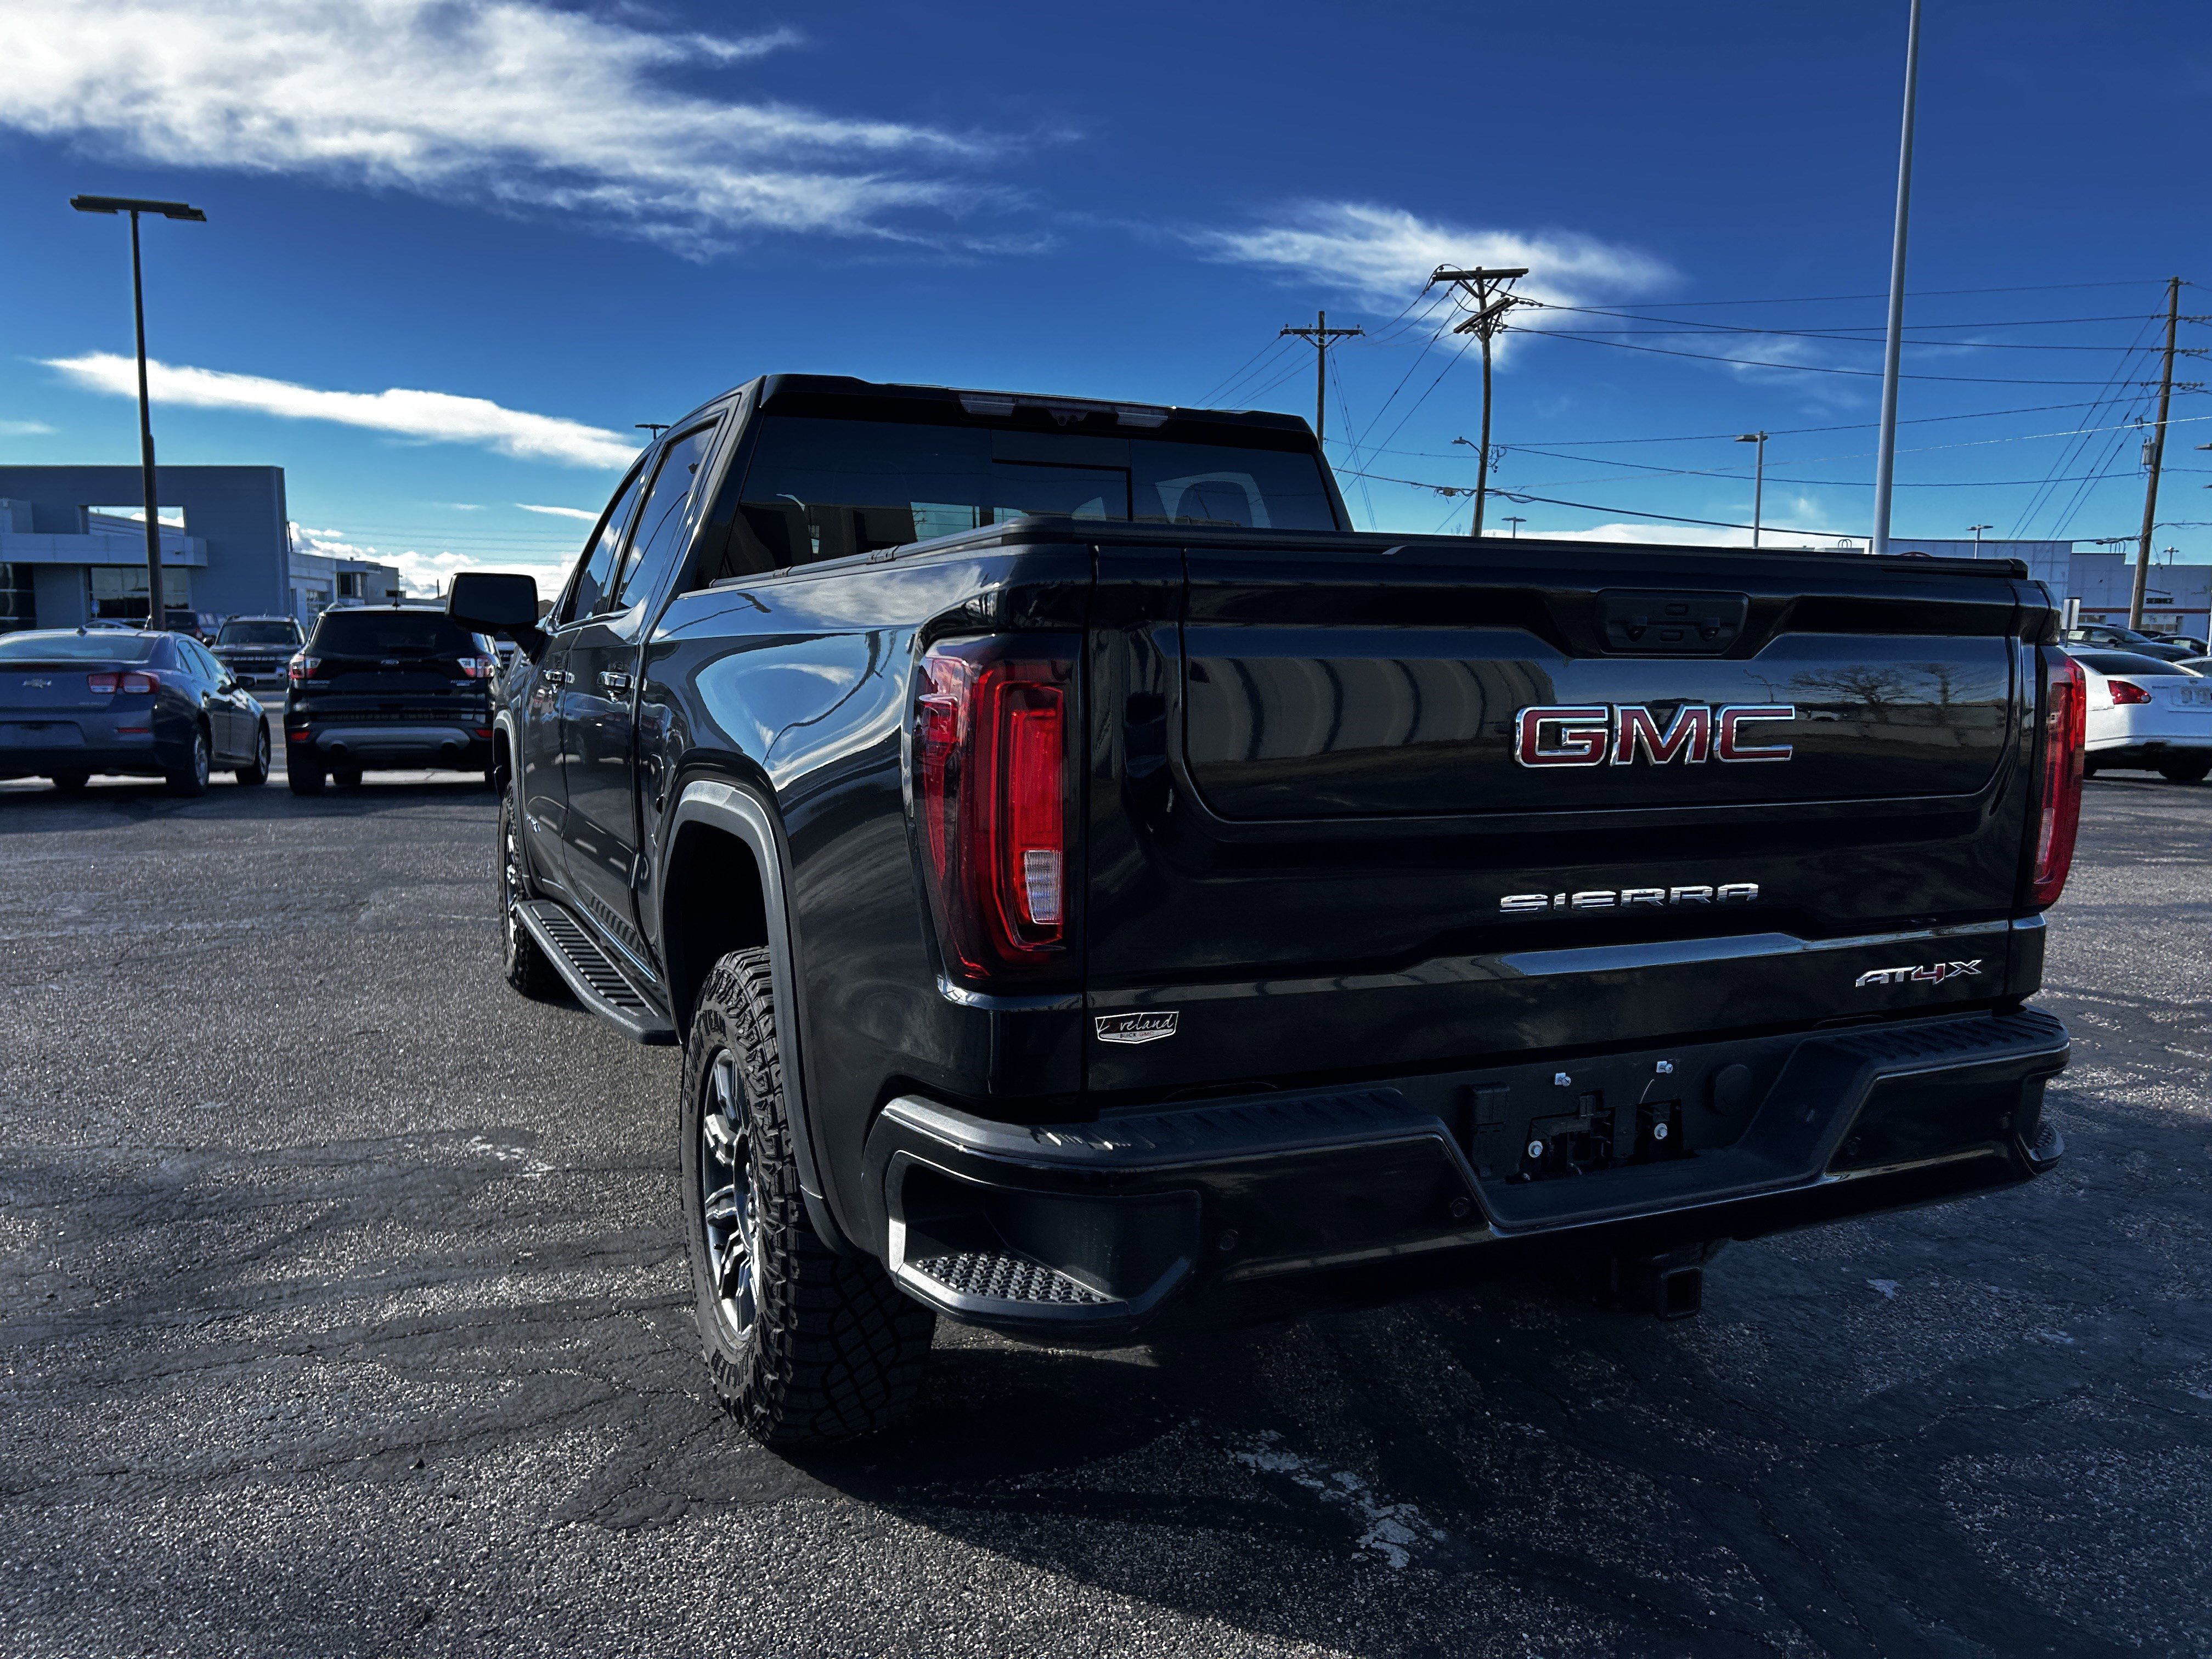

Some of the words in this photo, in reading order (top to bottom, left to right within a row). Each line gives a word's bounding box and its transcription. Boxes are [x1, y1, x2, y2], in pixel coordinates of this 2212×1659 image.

[1514, 703, 1796, 768] GMC
[1499, 883, 1759, 913] SIERRA
[1855, 959, 1982, 988] AT4X
